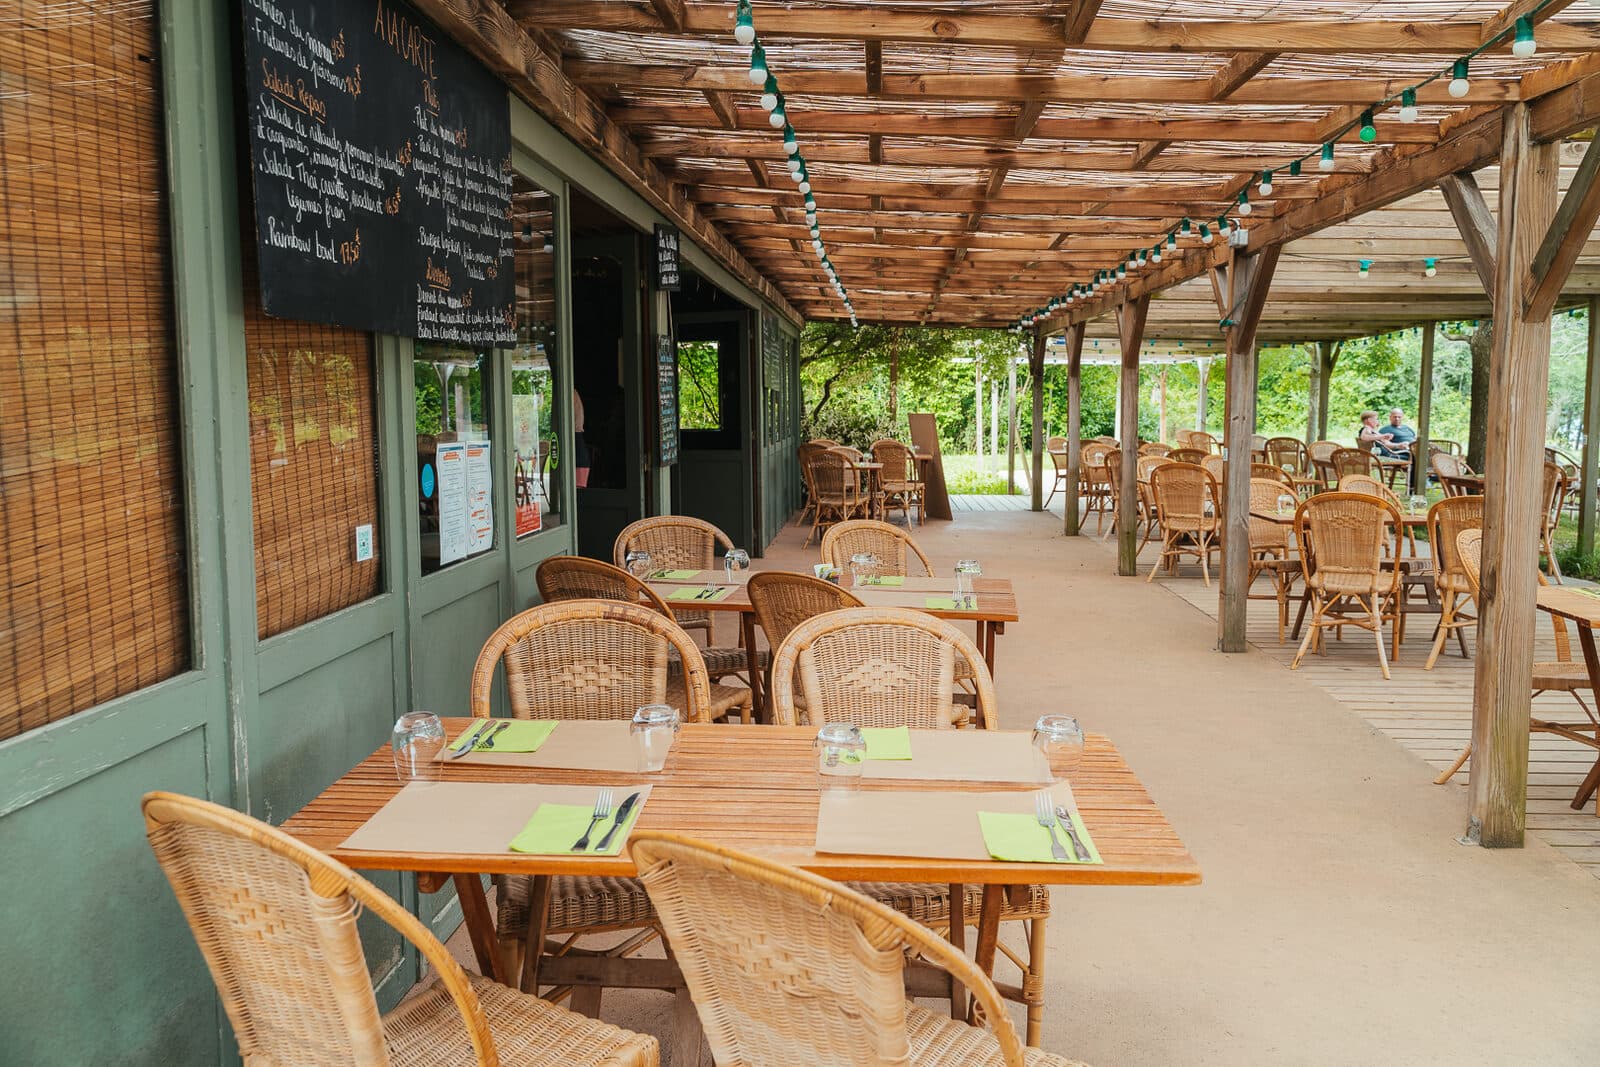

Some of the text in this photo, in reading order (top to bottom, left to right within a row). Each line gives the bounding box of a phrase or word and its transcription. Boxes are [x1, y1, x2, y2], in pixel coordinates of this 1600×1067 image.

[290, 9, 304, 41] du
[305, 32, 334, 65] menu
[375, 0, 384, 40] A
[401, 17, 437, 80] CARTE
[262, 58, 326, 117] Salade Repas
[297, 44, 308, 70] de
[311, 60, 346, 93] poissons
[260, 93, 293, 130] Salade
[295, 114, 307, 137] de
[263, 148, 295, 179] Salade
[325, 198, 346, 228] frais
[268, 216, 311, 253] Rainbow
[315, 229, 338, 263] bowl
